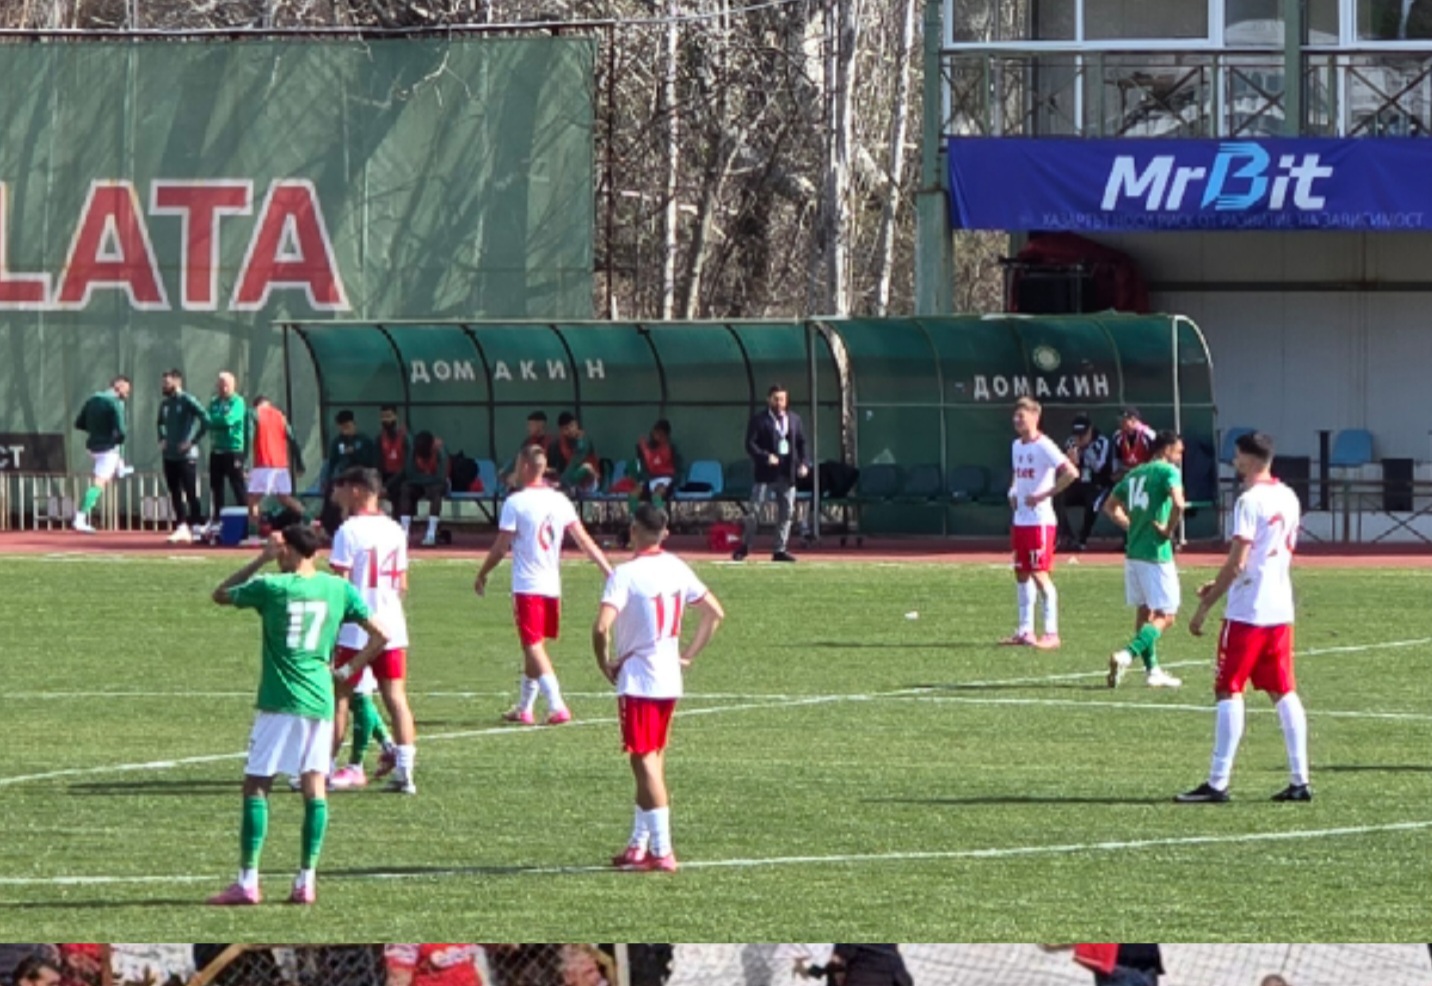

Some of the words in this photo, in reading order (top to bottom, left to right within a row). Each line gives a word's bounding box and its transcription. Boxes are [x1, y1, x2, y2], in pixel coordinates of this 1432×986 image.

[1101, 142, 1333, 211] MrBit
[364, 546, 403, 590] 14
[286, 600, 328, 652] 17
[652, 590, 682, 638] 11
